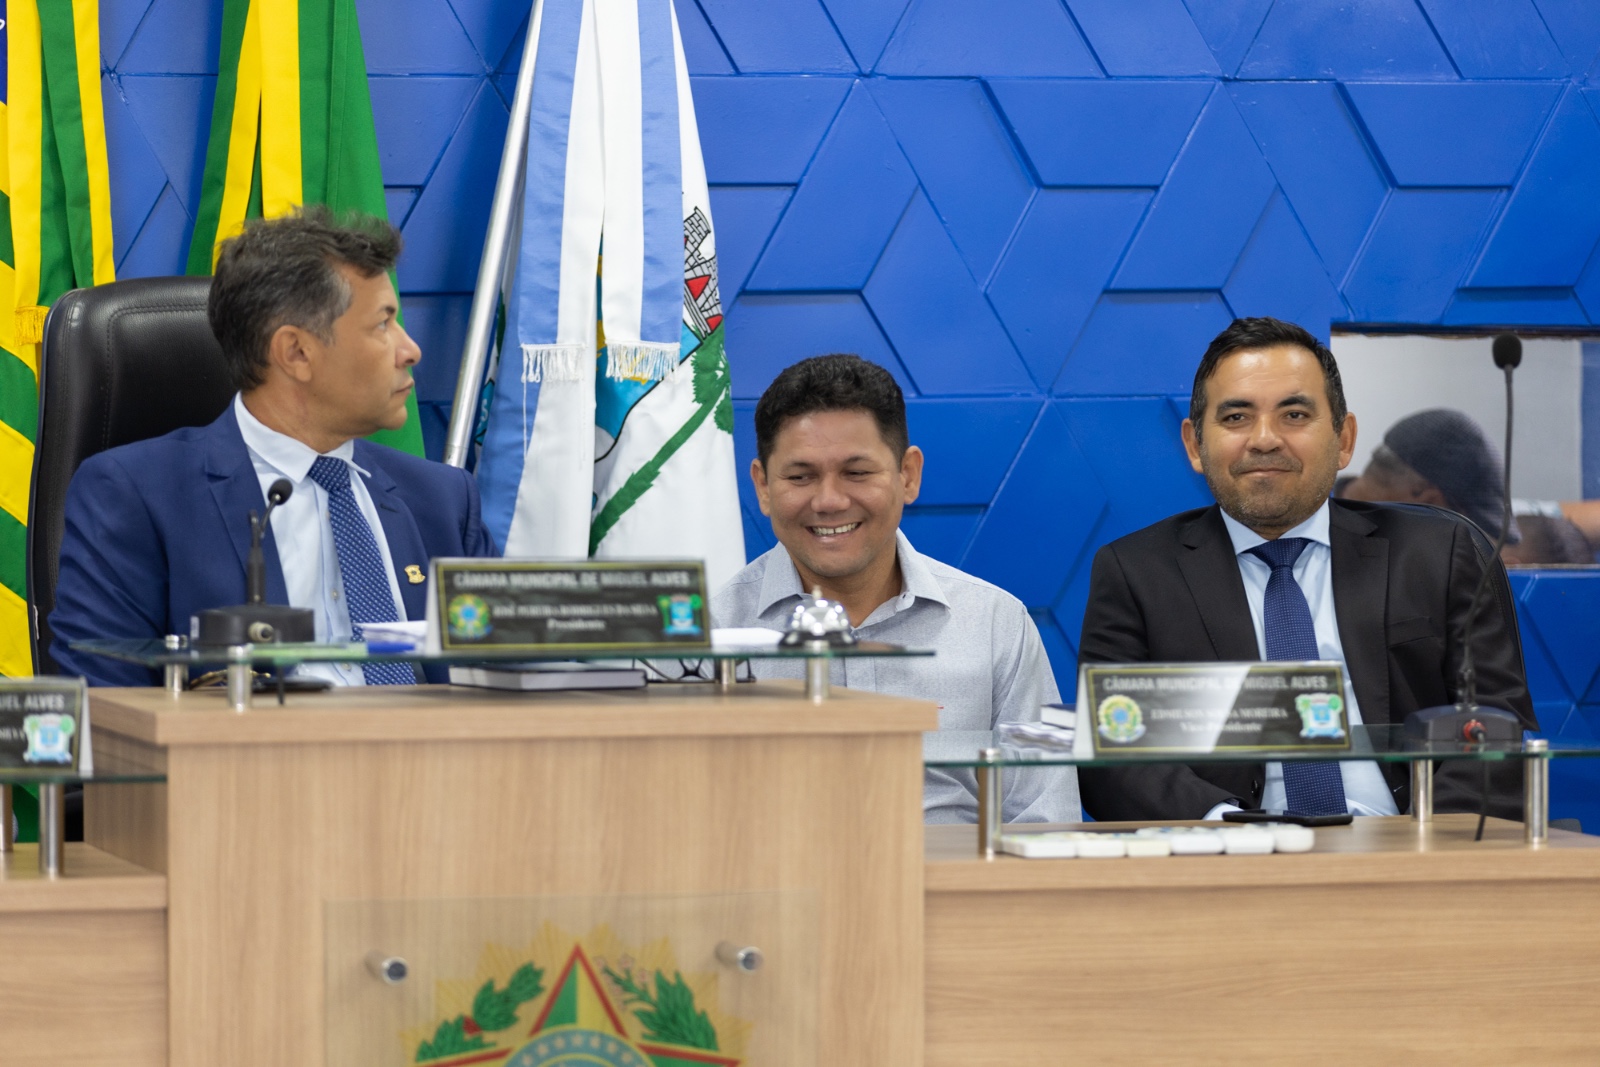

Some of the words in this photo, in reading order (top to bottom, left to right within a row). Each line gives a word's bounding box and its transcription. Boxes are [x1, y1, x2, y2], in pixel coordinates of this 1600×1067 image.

[453, 570, 508, 588] CÂMARA
[509, 571, 579, 588] MUNICIPAL
[580, 572, 598, 587] DE
[601, 571, 648, 587] MIGUEL
[651, 570, 691, 587] ALVES
[546, 617, 606, 631] Presidente
[1103, 673, 1155, 691] CÂMARA
[1156, 675, 1223, 691] MUNICIPAL
[1244, 675, 1288, 690] MIGUEL
[1291, 675, 1328, 690] ALVES
[24, 693, 65, 711] ALVES
[1240, 707, 1288, 719] MOREIRA
